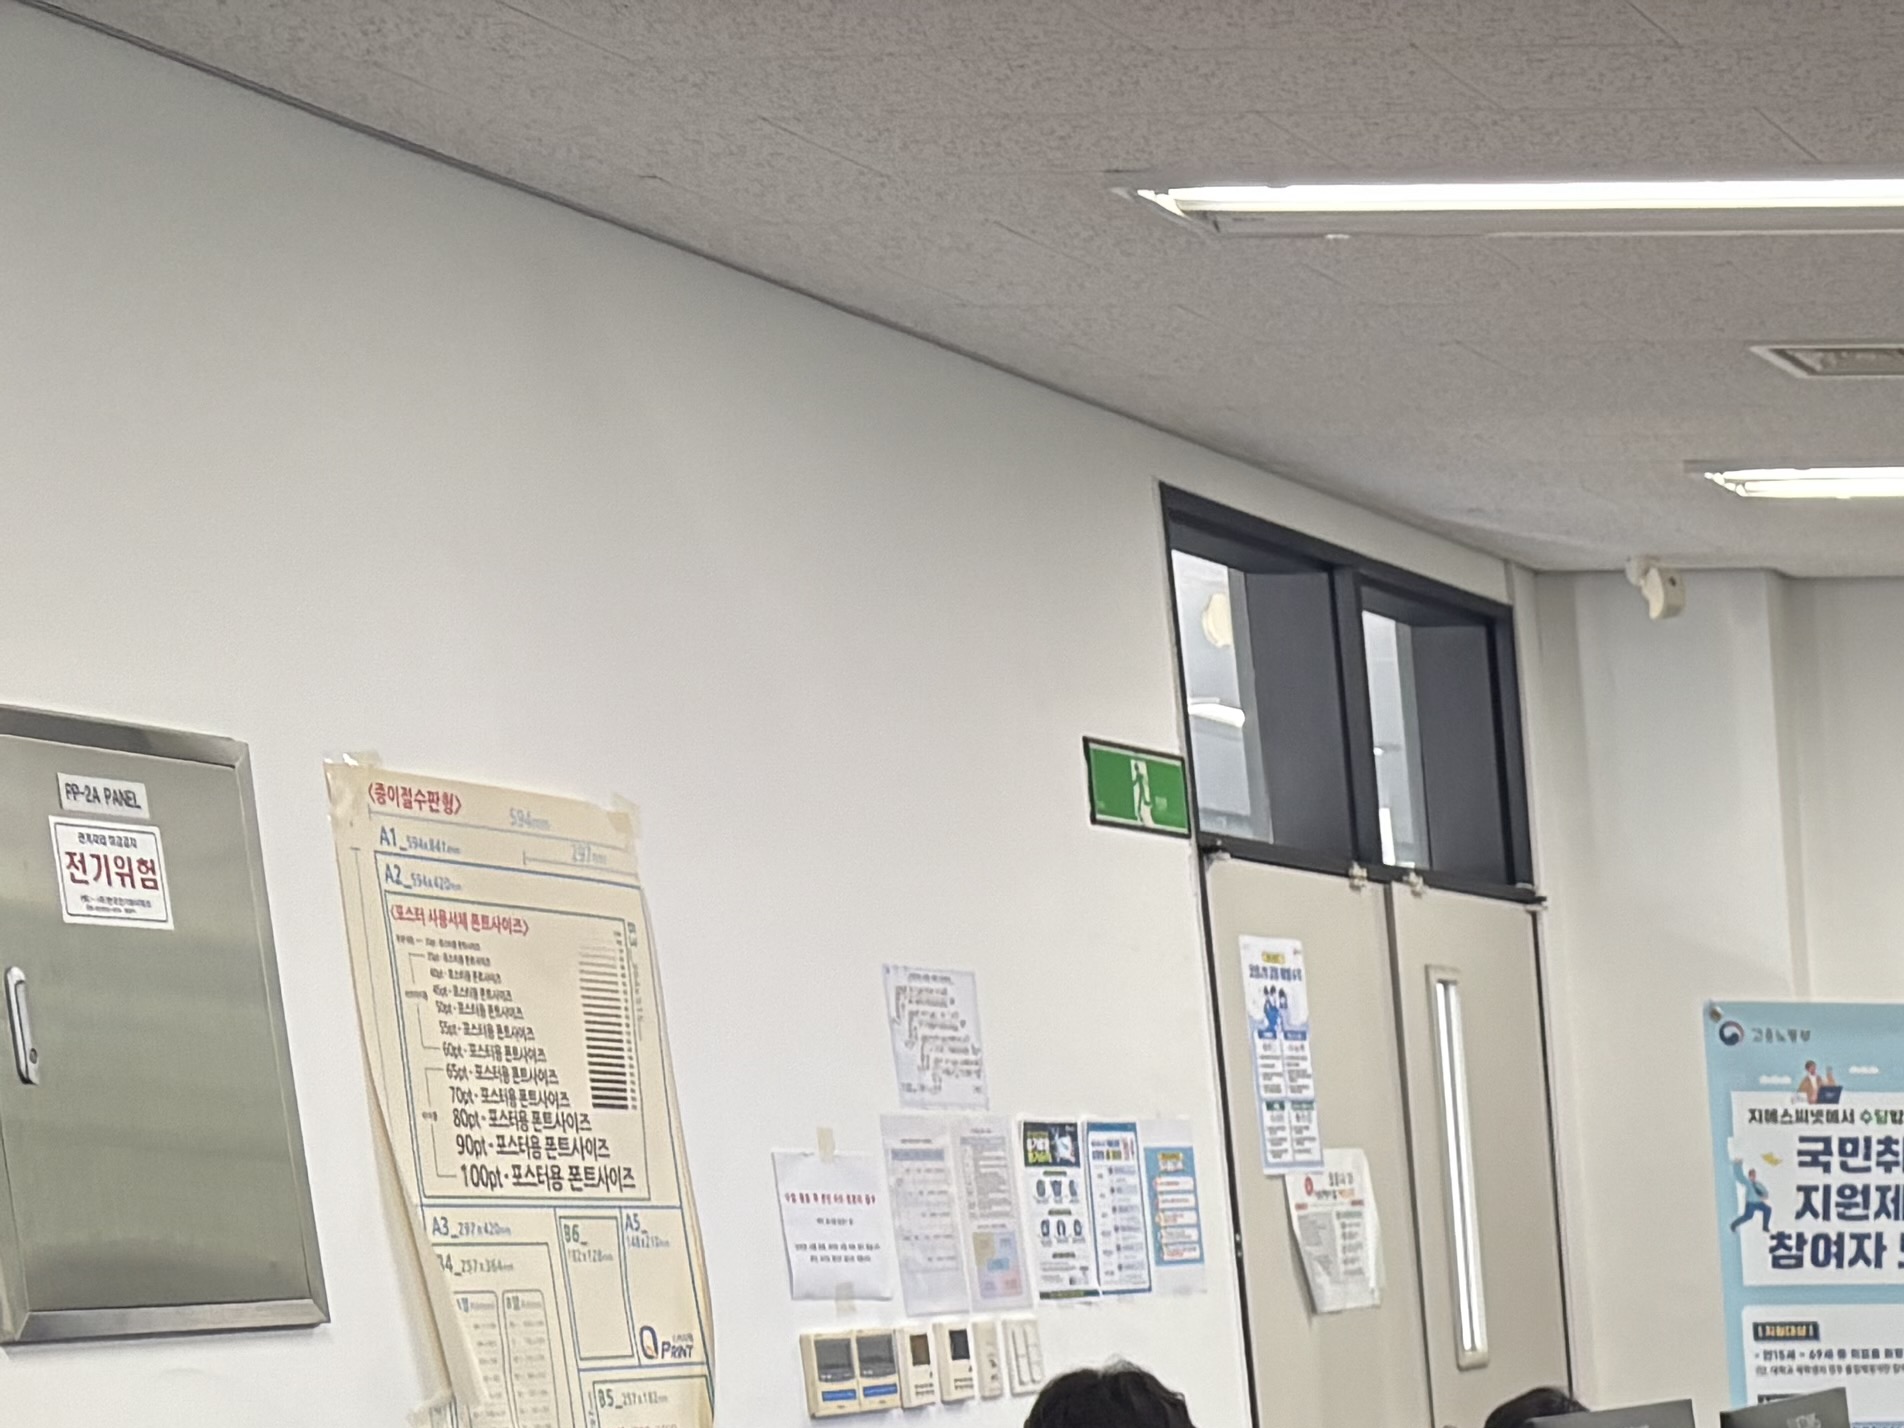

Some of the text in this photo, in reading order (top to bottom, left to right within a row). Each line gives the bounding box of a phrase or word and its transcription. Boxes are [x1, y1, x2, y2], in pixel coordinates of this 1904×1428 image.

[103, 787, 142, 809] PANEL
[65, 851, 159, 891] 전기위험
[453, 1109, 481, 1131] 80pt
[488, 1109, 529, 1132] 포스터용
[531, 1111, 592, 1133] 폰트사이즈
[456, 1134, 611, 1161] 90pt 포스터용 폰트사이즈
[460, 1163, 637, 1192] 100pt 포스터용 폰트사이즈
[1768, 1230, 1887, 1270] 참여자
